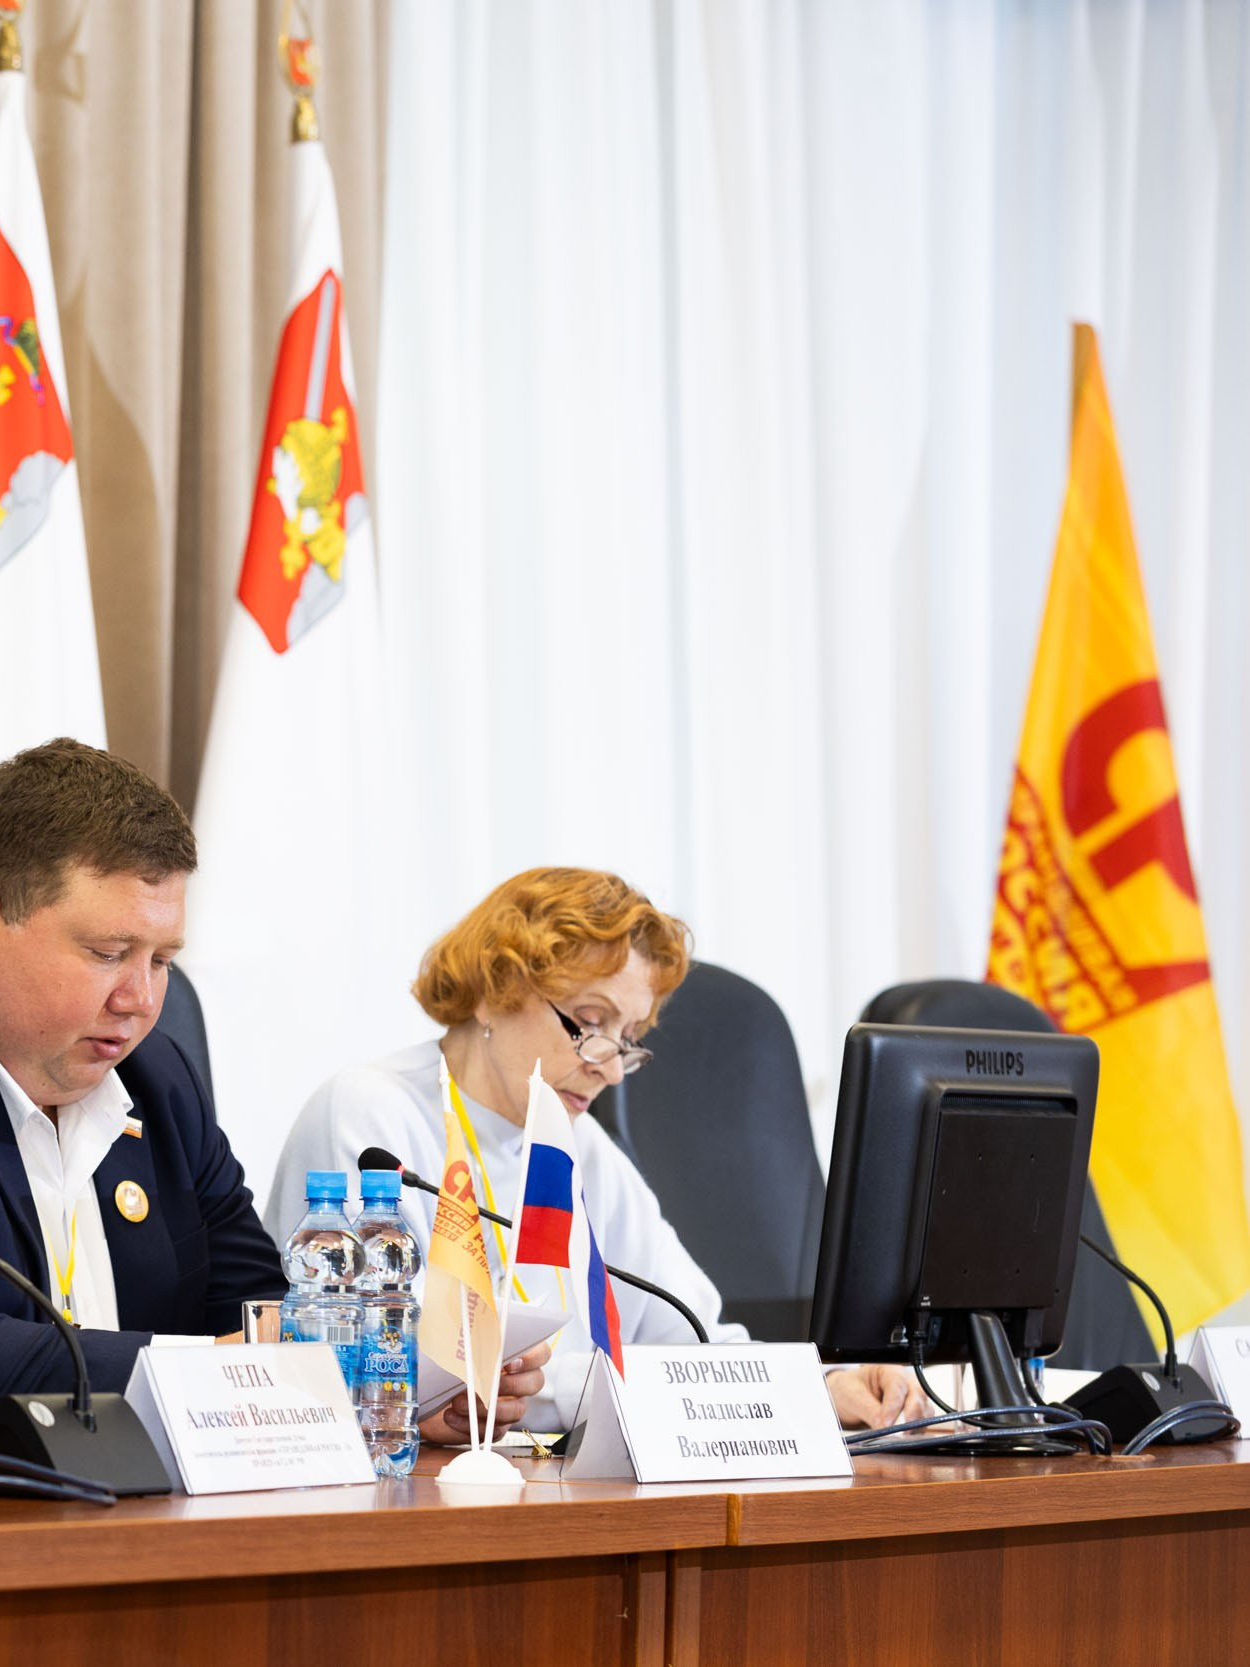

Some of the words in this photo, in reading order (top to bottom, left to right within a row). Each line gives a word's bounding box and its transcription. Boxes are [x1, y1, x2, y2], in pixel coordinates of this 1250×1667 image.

[965, 1050, 1024, 1076] PHILIPS
[222, 1364, 274, 1388] ЧЕПА
[365, 1357, 410, 1374] РОСА
[661, 1360, 771, 1384] ЗВОРЫКИН
[186, 1403, 248, 1430] Алексей
[249, 1403, 338, 1427] Васильевич
[682, 1398, 773, 1421] Владислав
[677, 1435, 800, 1463] Валерианович
